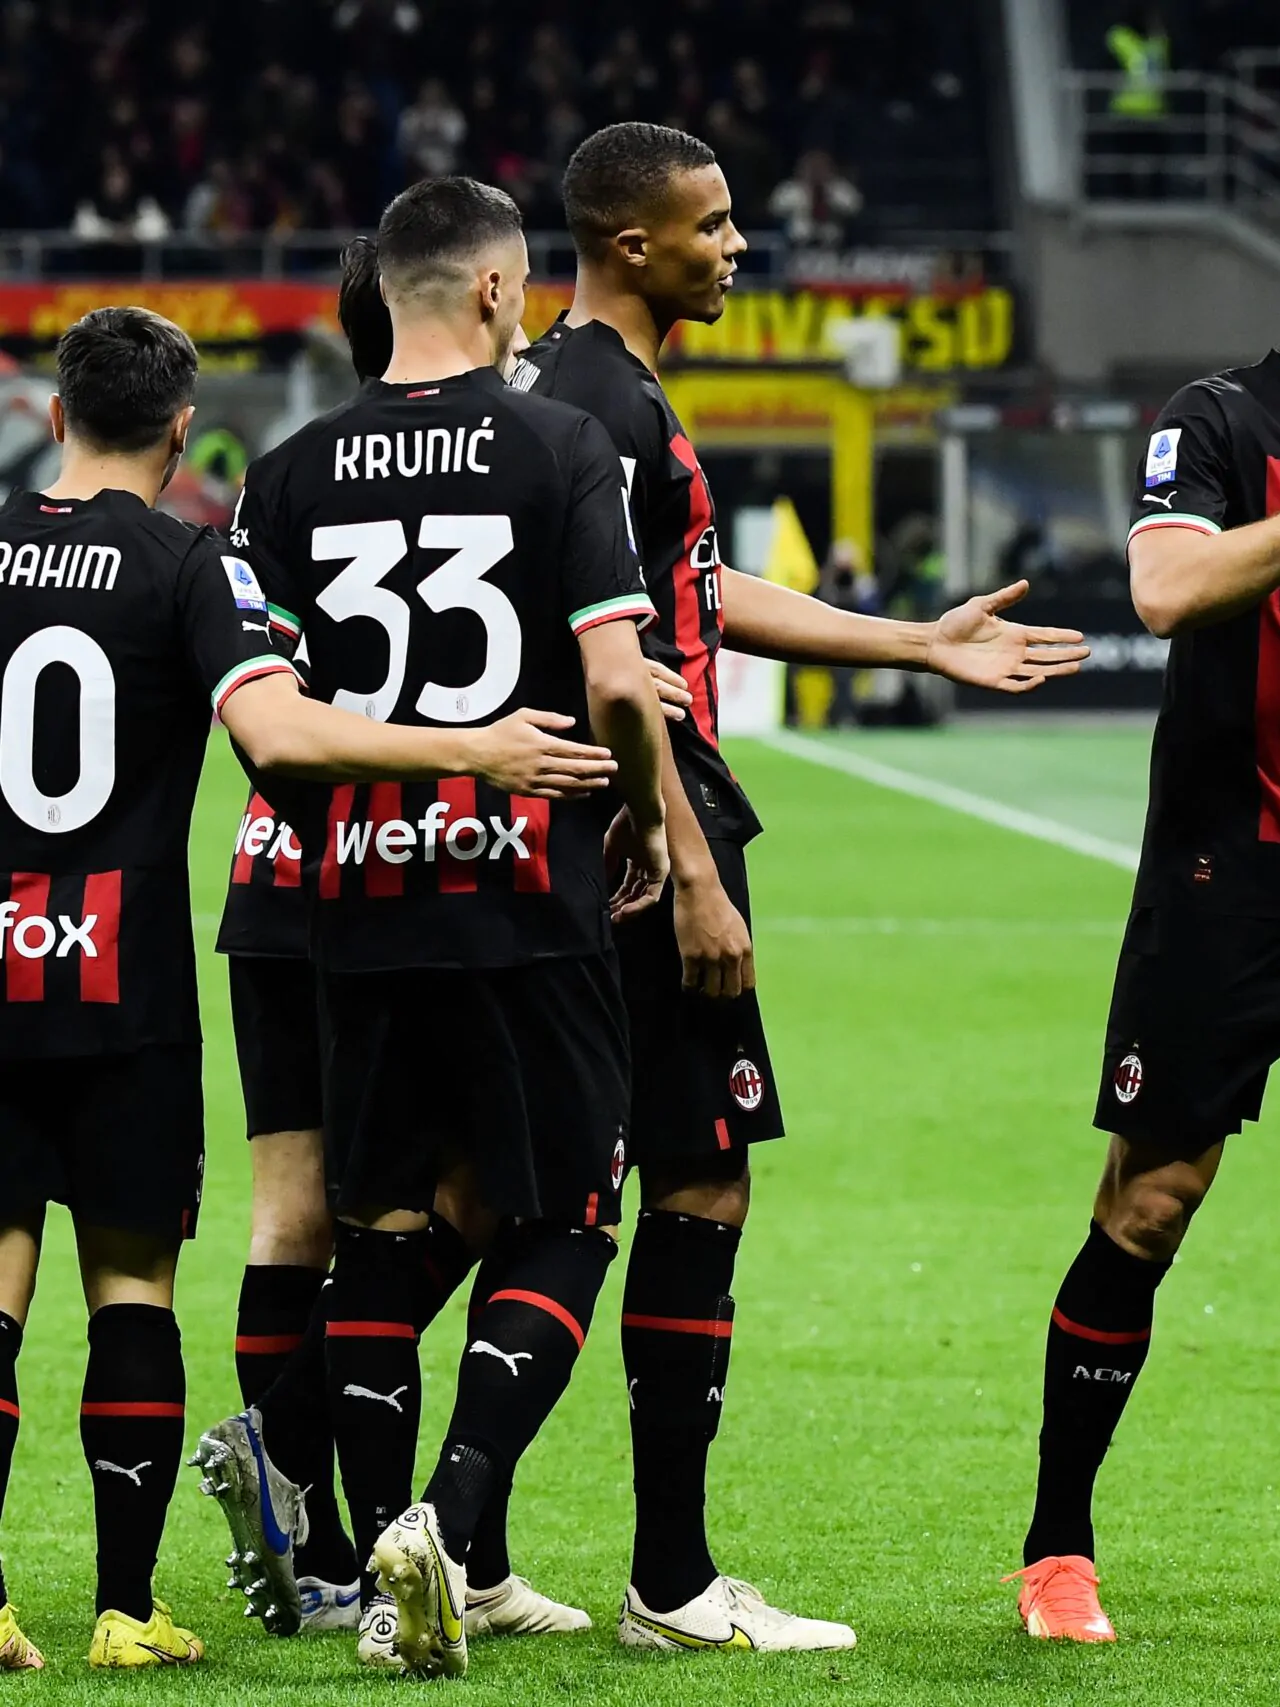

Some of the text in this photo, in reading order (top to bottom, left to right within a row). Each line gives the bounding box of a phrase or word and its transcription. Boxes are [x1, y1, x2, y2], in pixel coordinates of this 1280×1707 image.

[334, 416, 495, 481] KRUNIĆ
[311, 515, 522, 723] 33
[336, 801, 531, 865] wefox
[1073, 1365, 1132, 1384] ACM
